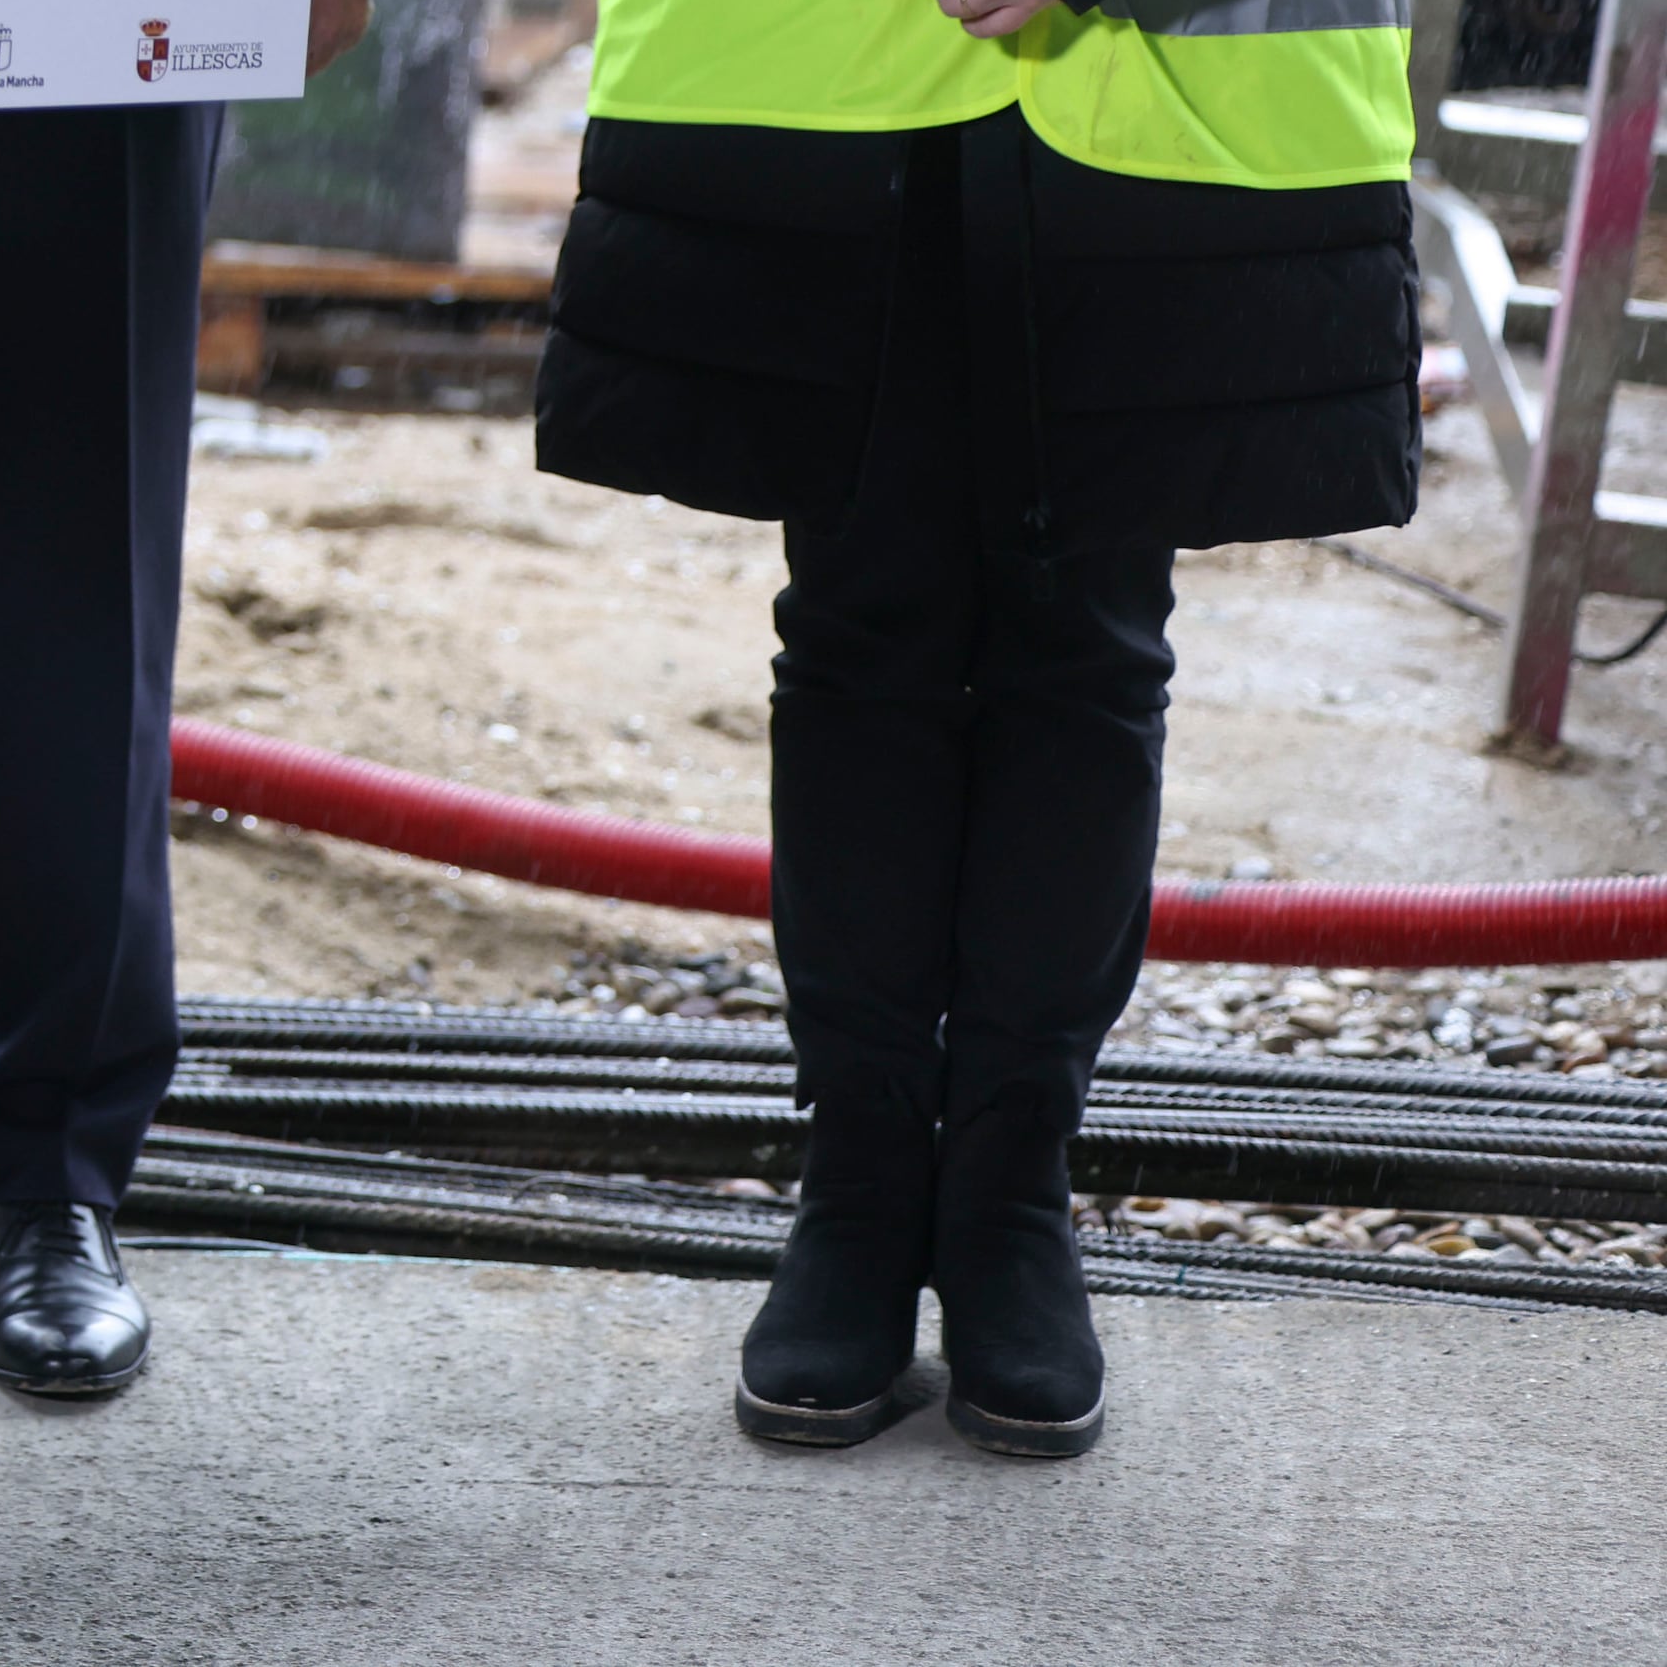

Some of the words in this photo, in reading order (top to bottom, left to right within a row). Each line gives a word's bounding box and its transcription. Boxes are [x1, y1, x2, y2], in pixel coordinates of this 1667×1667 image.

[173, 43, 249, 54] AYUNTAMIENTO
[250, 42, 264, 51] DE
[171, 52, 263, 71] ILLESCAS
[6, 75, 45, 88] Mancha
